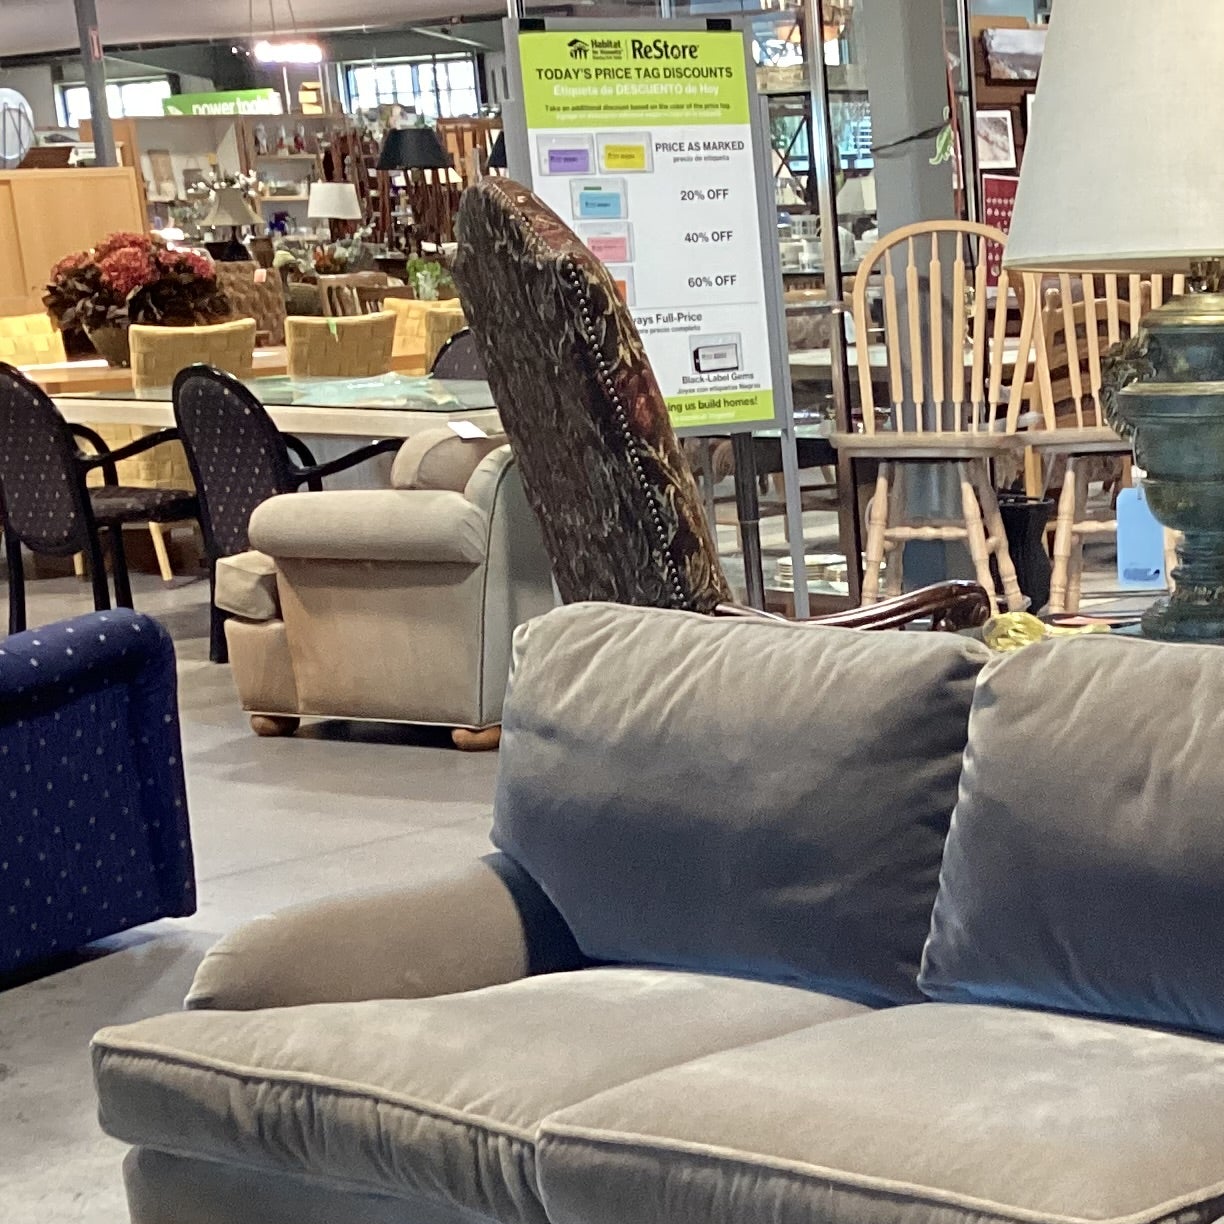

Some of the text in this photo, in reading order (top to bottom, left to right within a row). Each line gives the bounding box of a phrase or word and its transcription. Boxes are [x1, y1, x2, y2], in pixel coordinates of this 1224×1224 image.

[591, 39, 621, 48] Habitat
[631, 38, 698, 60] ReStore
[536, 66, 733, 80] TODAY'S PRICE TAG DISCOUNTS
[601, 84, 613, 96] de
[616, 82, 682, 96] DESCUENTO
[685, 83, 697, 95] de
[699, 83, 719, 97] Hoy
[191, 101, 235, 115] power
[545, 104, 561, 112] Take
[603, 103, 629, 111] discount
[704, 102, 719, 110] price
[655, 140, 745, 152] PRICE AS MARKED
[680, 188, 729, 201] 20% OFF
[684, 230, 733, 243] 40% OFF
[688, 275, 737, 288] 60% OFF
[656, 312, 703, 324] Full-Price
[682, 371, 755, 385] Black-Label Gems
[667, 396, 758, 413] ing us build homes!
